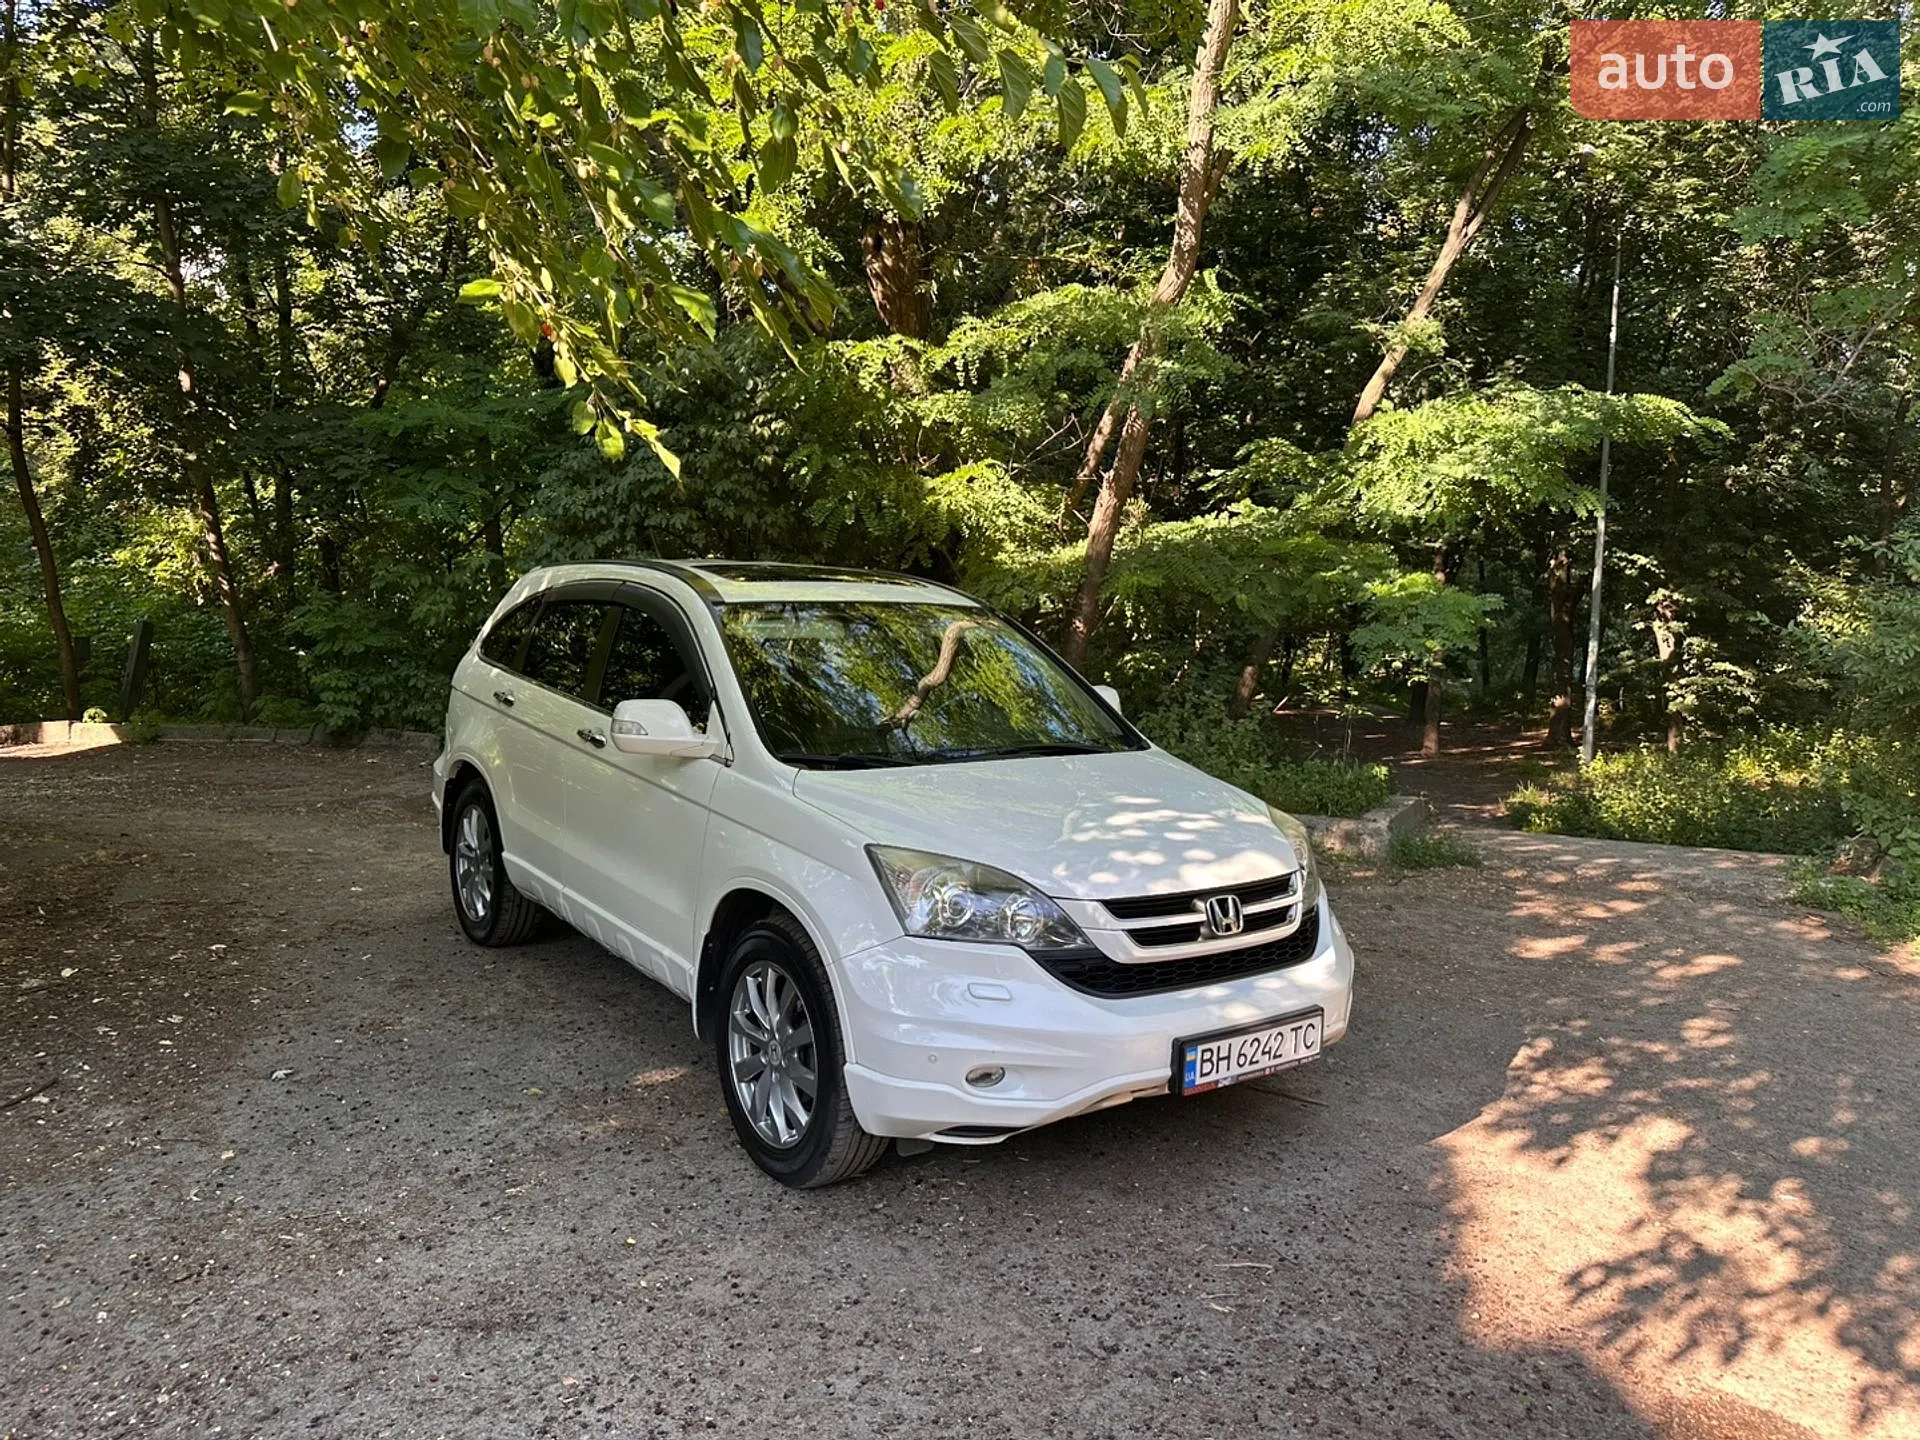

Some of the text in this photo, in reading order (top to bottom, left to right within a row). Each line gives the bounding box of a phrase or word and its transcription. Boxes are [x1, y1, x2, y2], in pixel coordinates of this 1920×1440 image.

[1200, 1023, 1315, 1078] BH 6242 TC
